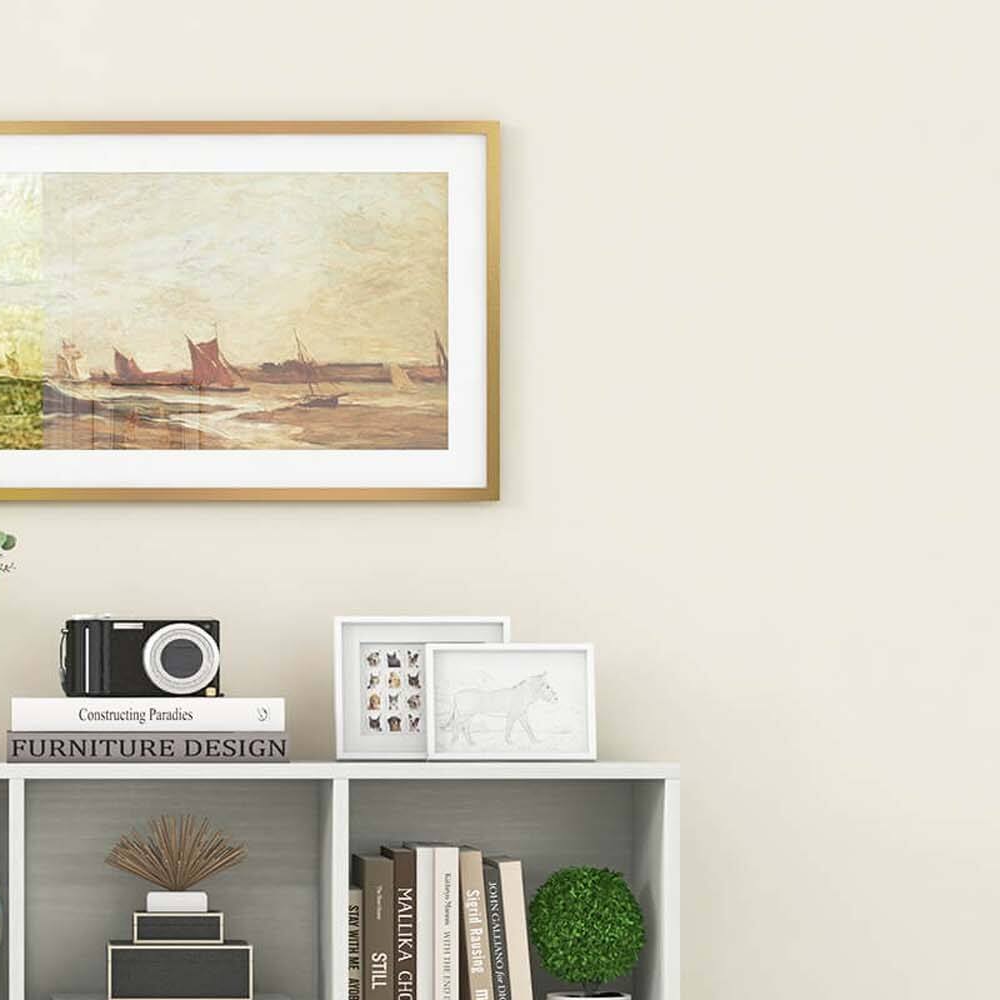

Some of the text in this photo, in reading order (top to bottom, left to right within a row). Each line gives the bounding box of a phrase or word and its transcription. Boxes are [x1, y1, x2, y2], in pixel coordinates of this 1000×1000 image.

[78, 707, 193, 724] Constructing Paradies
[11, 738, 288, 758] FURNITURE DESIGN
[487, 880, 499, 912] JOHN
[397, 887, 413, 962] MALLIKA
[465, 888, 486, 974] Sigrid Rausing
[490, 912, 504, 970] GALLIANO
[371, 952, 388, 990] STILL
